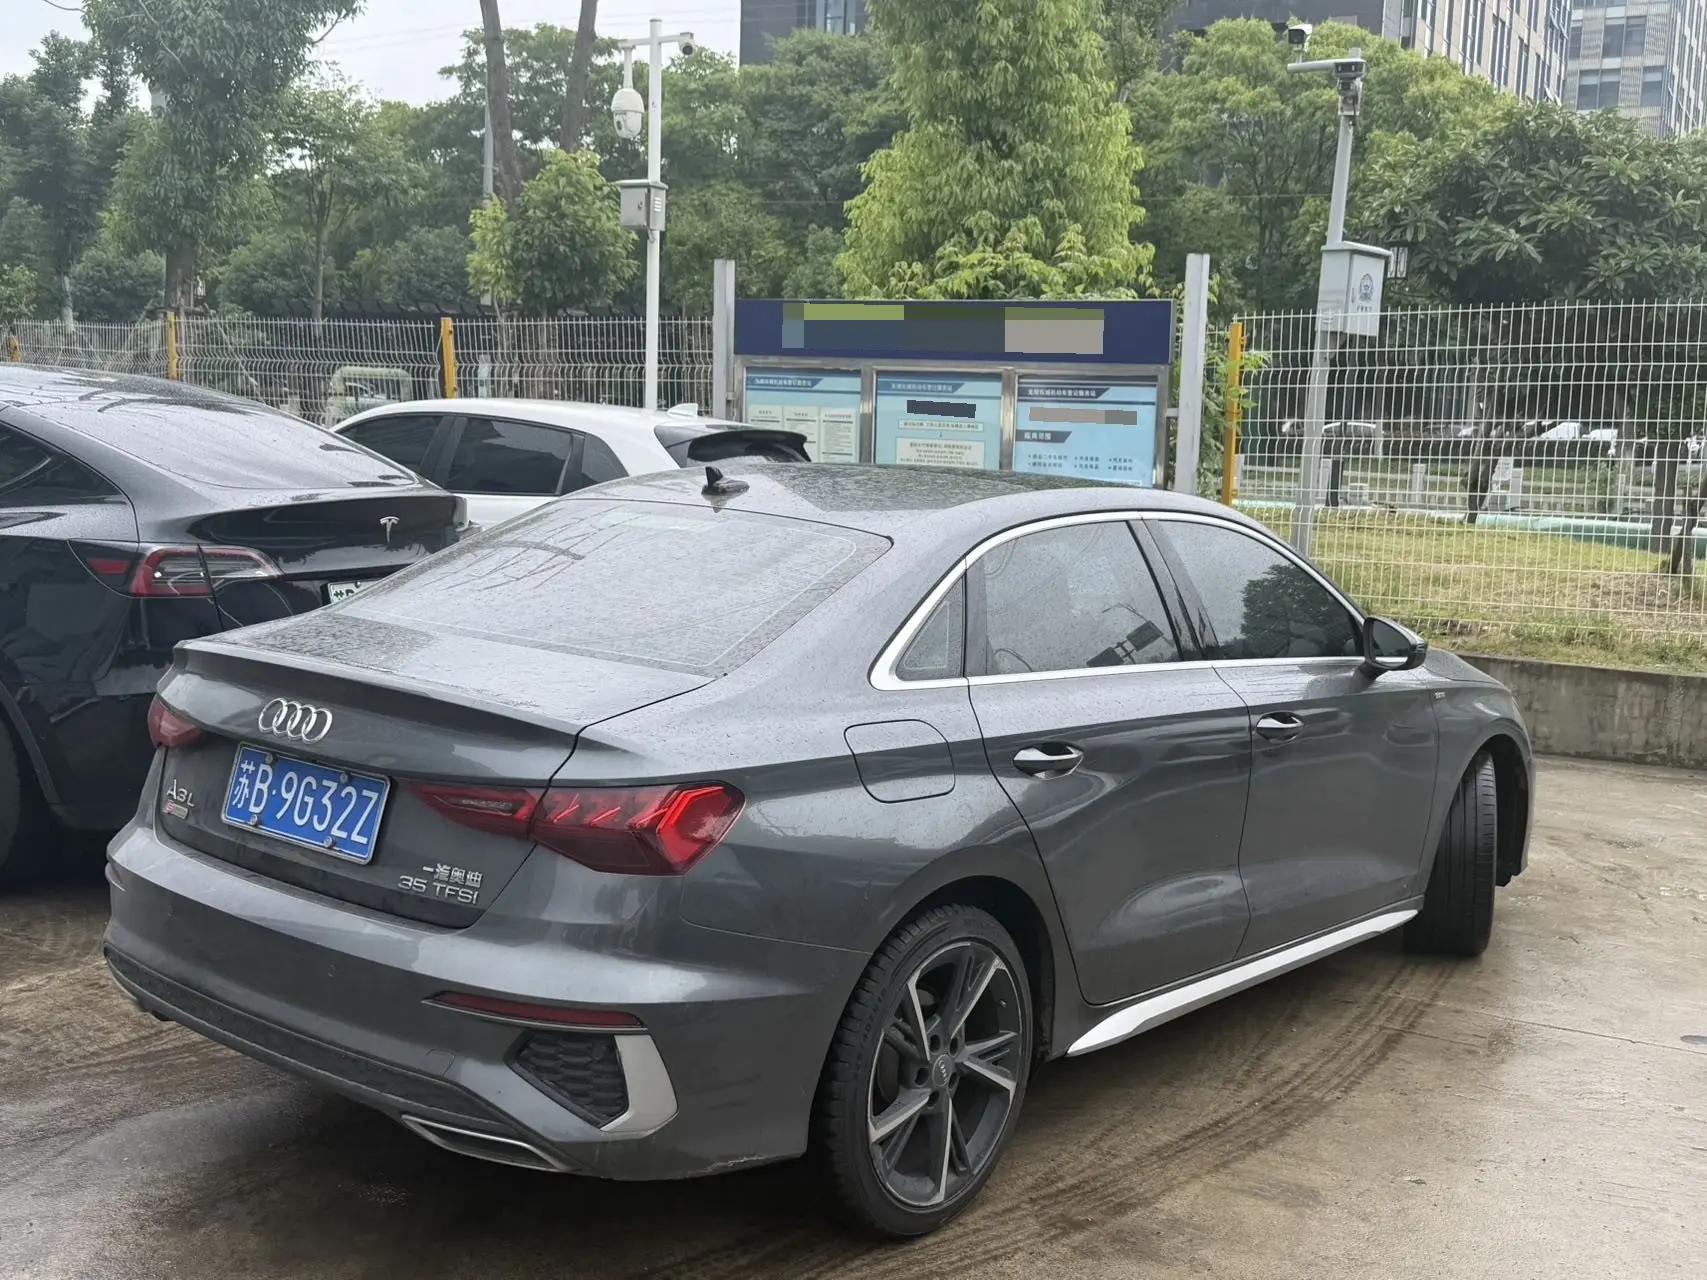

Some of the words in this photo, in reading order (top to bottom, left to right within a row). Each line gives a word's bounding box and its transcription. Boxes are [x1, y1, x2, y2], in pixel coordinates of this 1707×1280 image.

[166, 779, 195, 807] A3L
[398, 875, 428, 893] 35
[433, 882, 479, 905] TFSI
